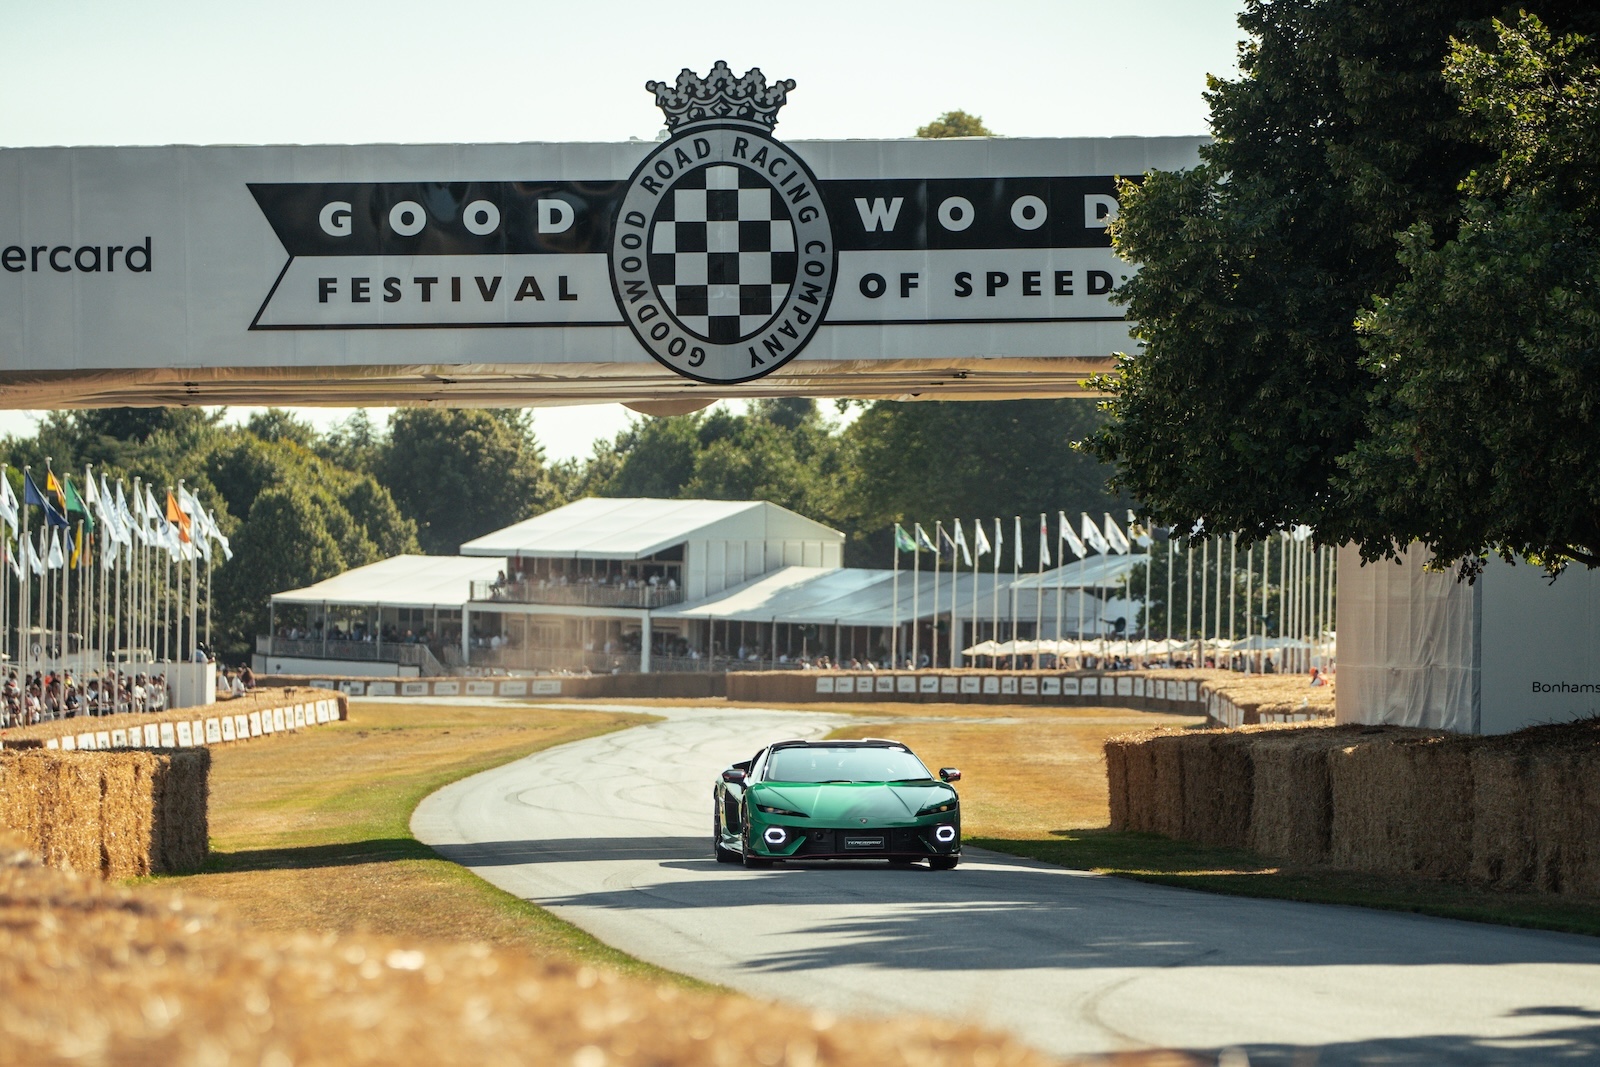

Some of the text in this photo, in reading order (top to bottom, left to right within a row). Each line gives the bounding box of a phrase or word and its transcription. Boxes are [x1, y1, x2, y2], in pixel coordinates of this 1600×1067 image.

[317, 193, 1120, 237] GOOD WOOD
[1, 236, 152, 273] ercard
[620, 136, 826, 368] GOODWOOD ROAD RACING COMPANY
[318, 270, 1114, 304] FESTIVAL OF SPEED
[1532, 681, 1600, 693] Bonhams
